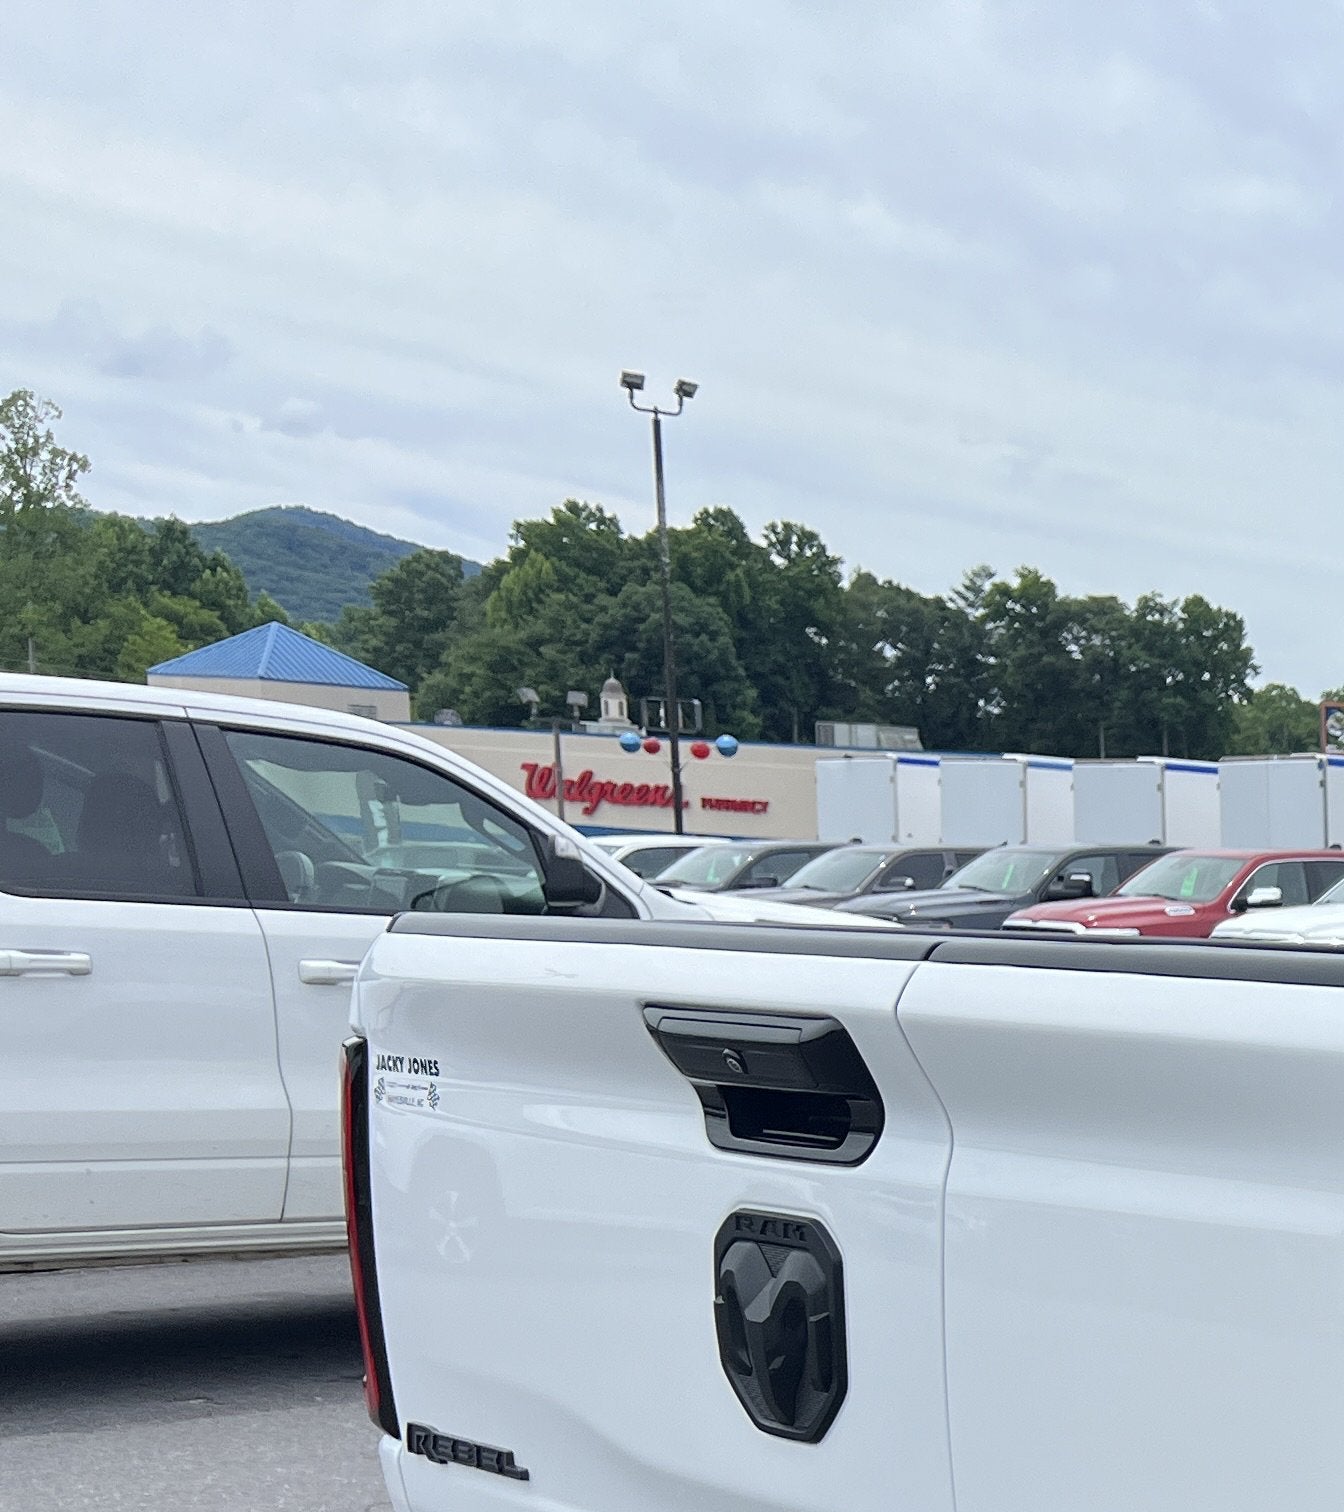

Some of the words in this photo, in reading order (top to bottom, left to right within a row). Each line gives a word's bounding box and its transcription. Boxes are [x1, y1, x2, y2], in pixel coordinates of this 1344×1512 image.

[521, 763, 689, 815] Walgreen
[376, 1054, 404, 1073] JACKY
[408, 1057, 439, 1077] JONES
[735, 1215, 808, 1242] RAM
[406, 1421, 529, 1481] REBEL
